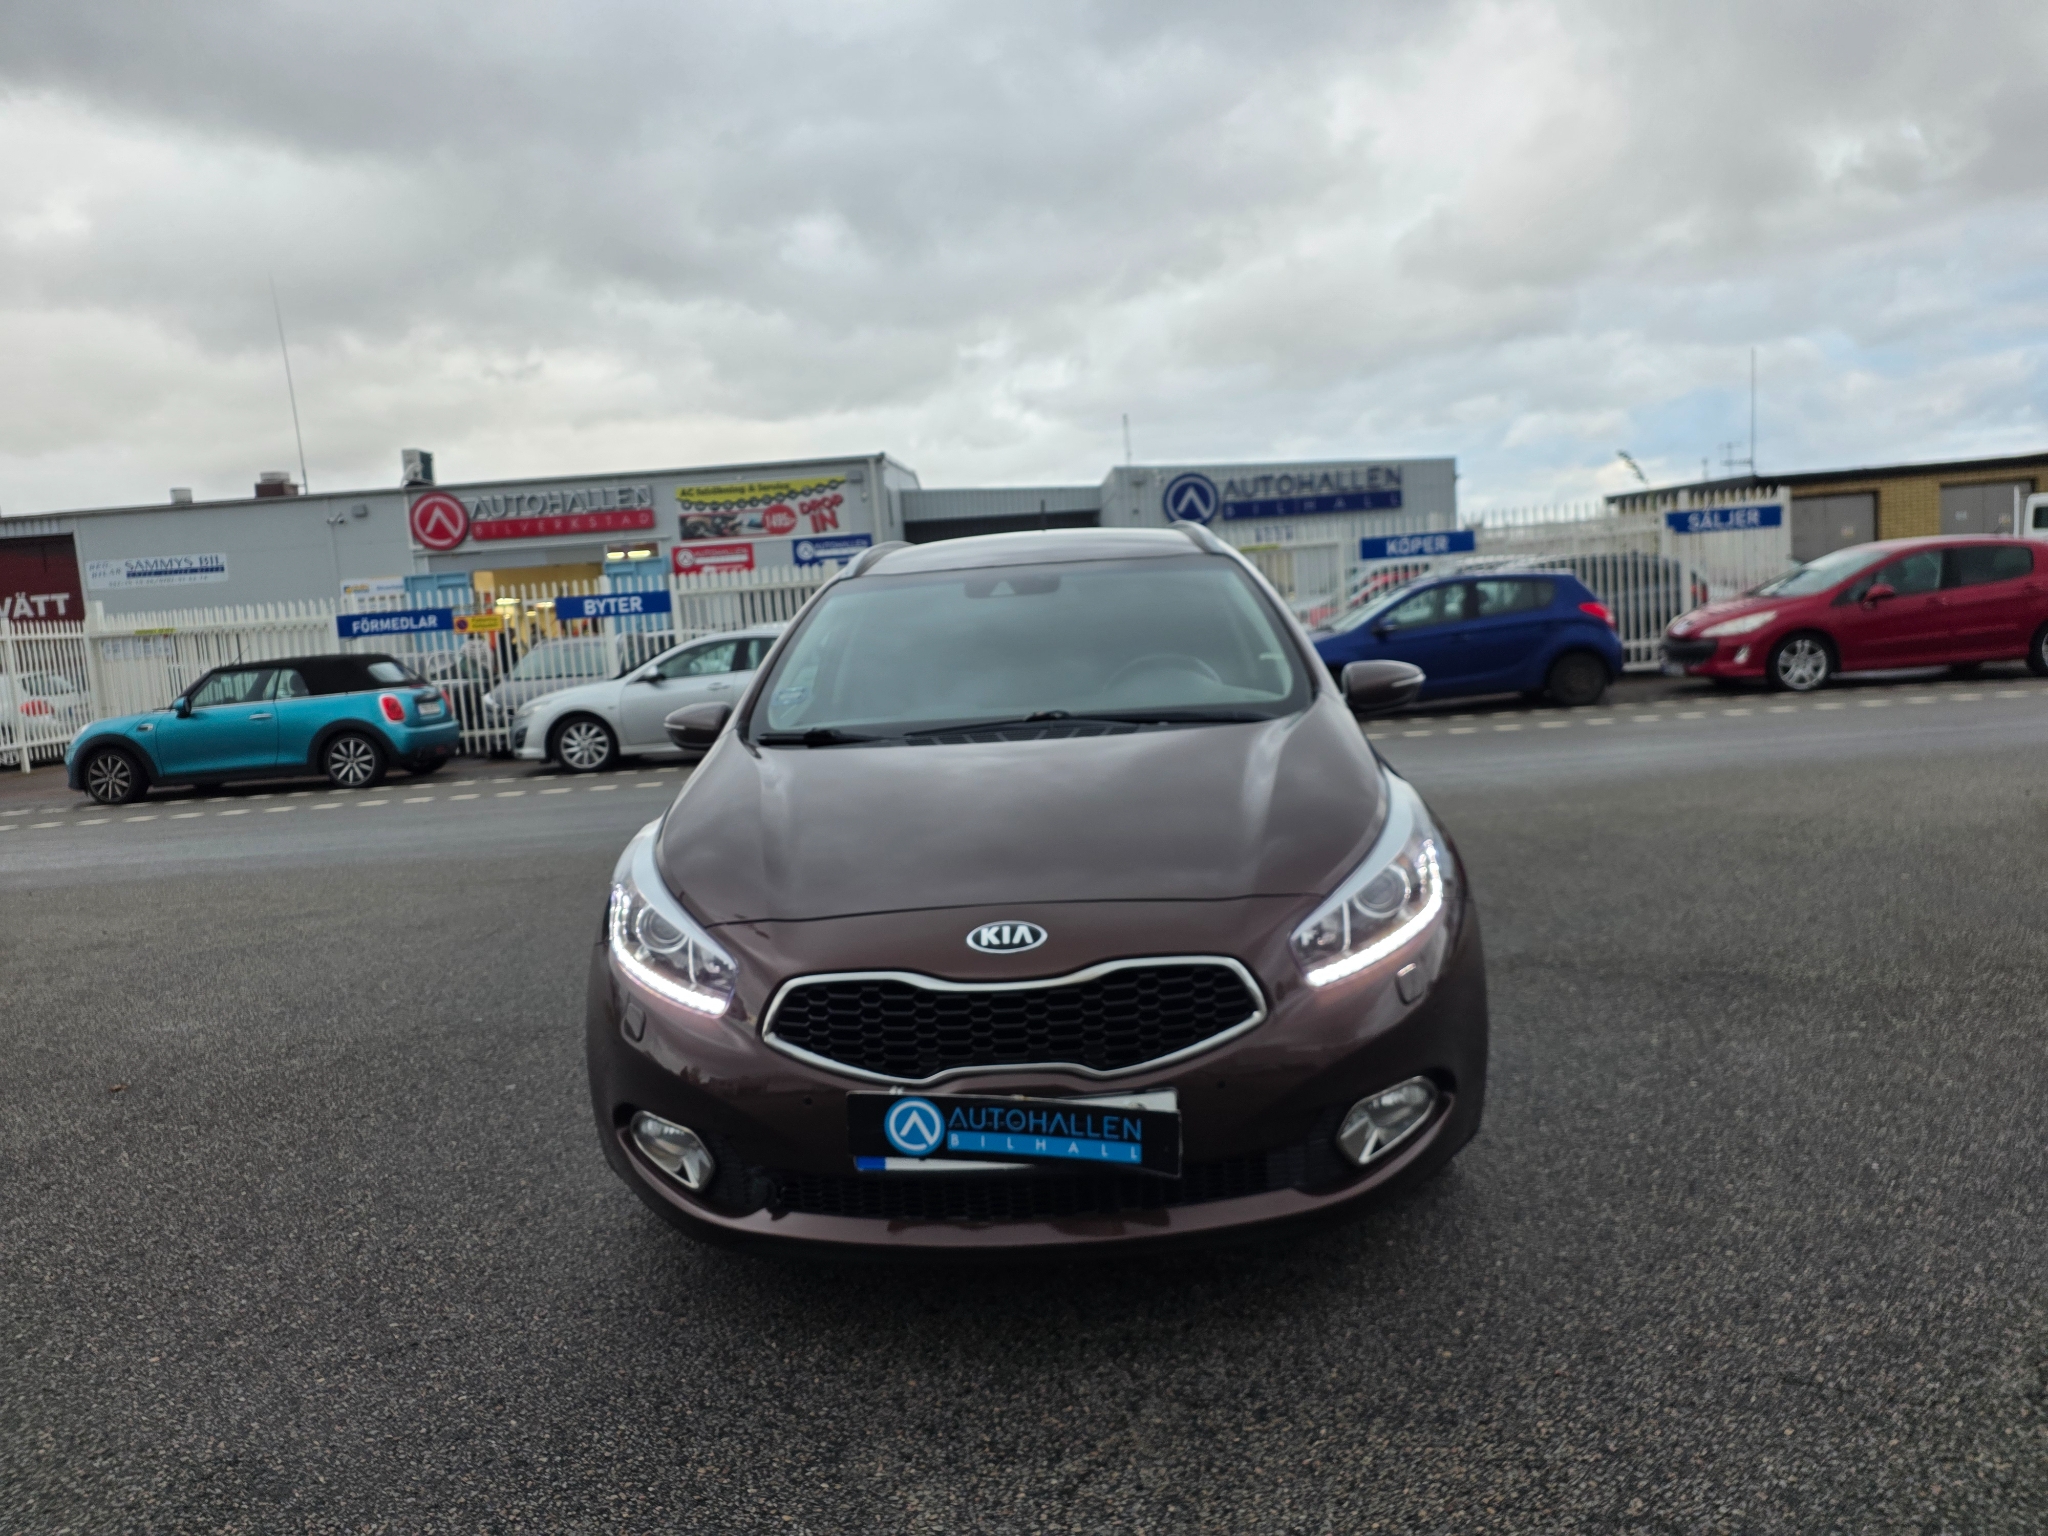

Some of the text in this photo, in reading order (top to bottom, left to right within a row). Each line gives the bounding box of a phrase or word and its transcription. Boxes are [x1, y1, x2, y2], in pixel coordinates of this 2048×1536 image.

[1223, 466, 1402, 498] AUTOHALLEN
[472, 484, 653, 519] AUTOHALLEN
[798, 494, 843, 514] DROP
[474, 511, 651, 535] BILVERKSTAD
[810, 508, 839, 533] IN
[1687, 508, 1760, 532] SÄLJER
[1386, 534, 1449, 556] KÖPER
[125, 556, 193, 572] SAMMYS
[583, 595, 644, 616] BYTER
[351, 614, 438, 634] FÖRMEDLAR
[979, 925, 1034, 946] KIA
[948, 1106, 1142, 1141] AUTOHALLEN
[950, 1133, 1138, 1160] BILHALL
